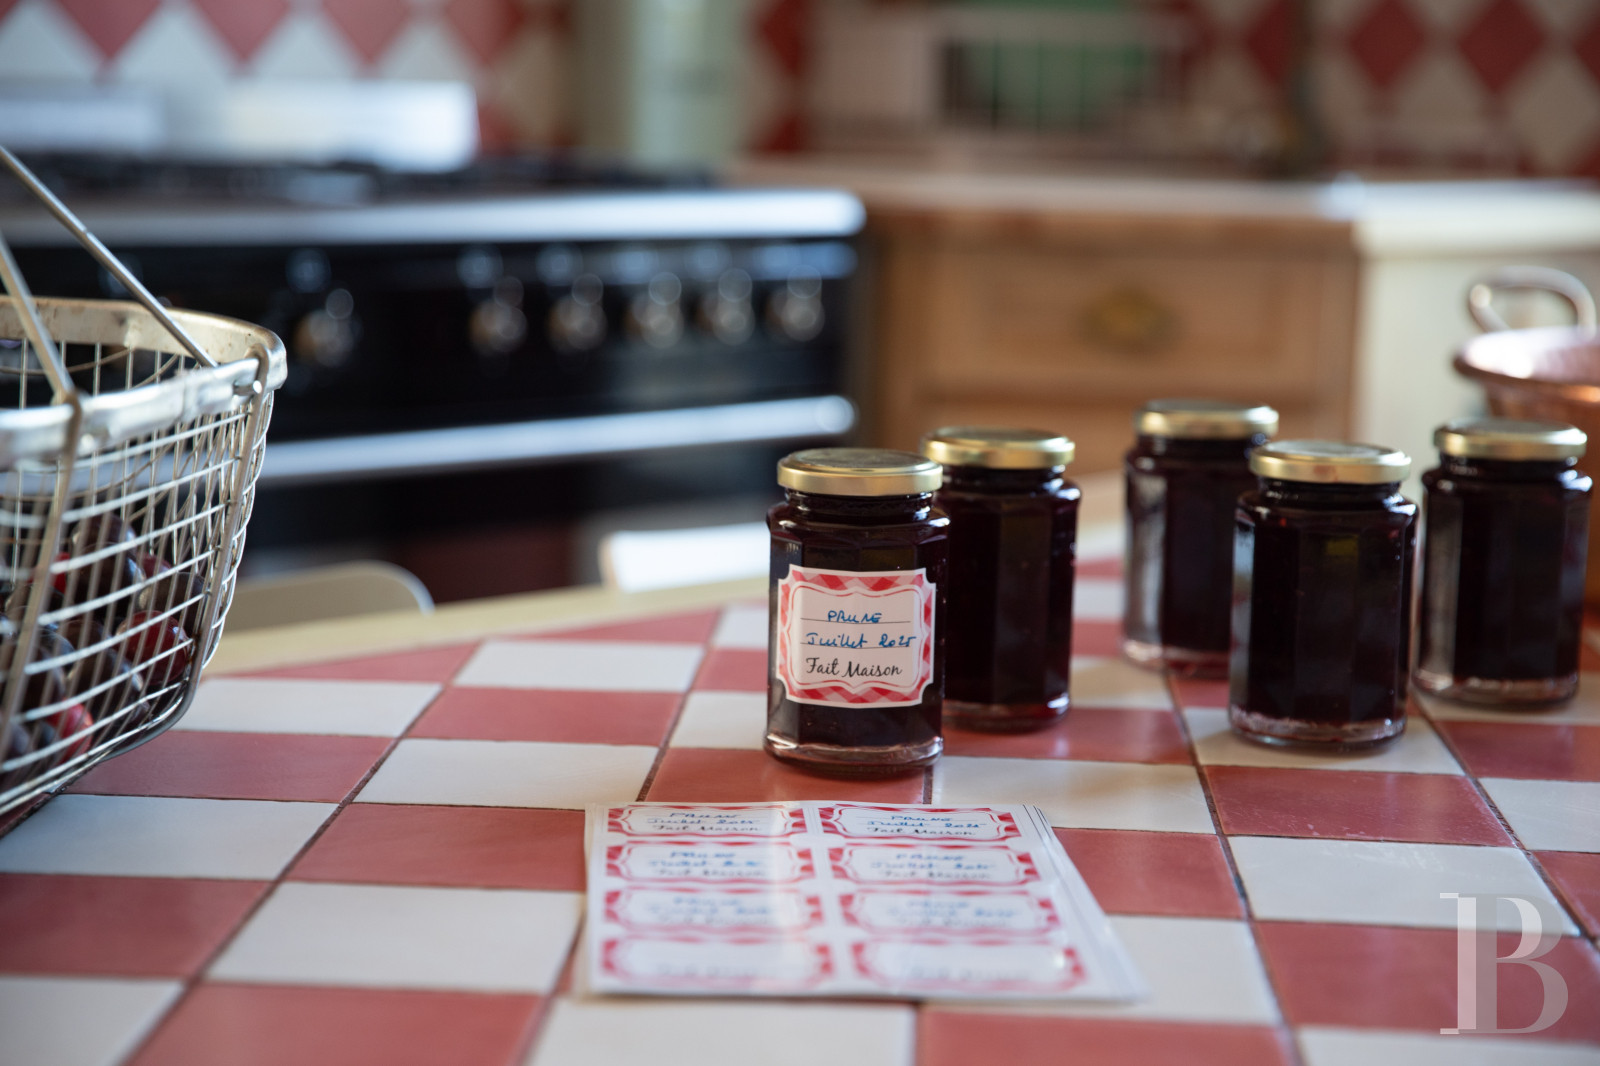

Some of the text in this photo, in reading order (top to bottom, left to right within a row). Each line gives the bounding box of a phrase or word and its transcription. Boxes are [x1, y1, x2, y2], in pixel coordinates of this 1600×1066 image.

[806, 632, 917, 649] Juillet 2025
[806, 657, 903, 678] Fait Maison
